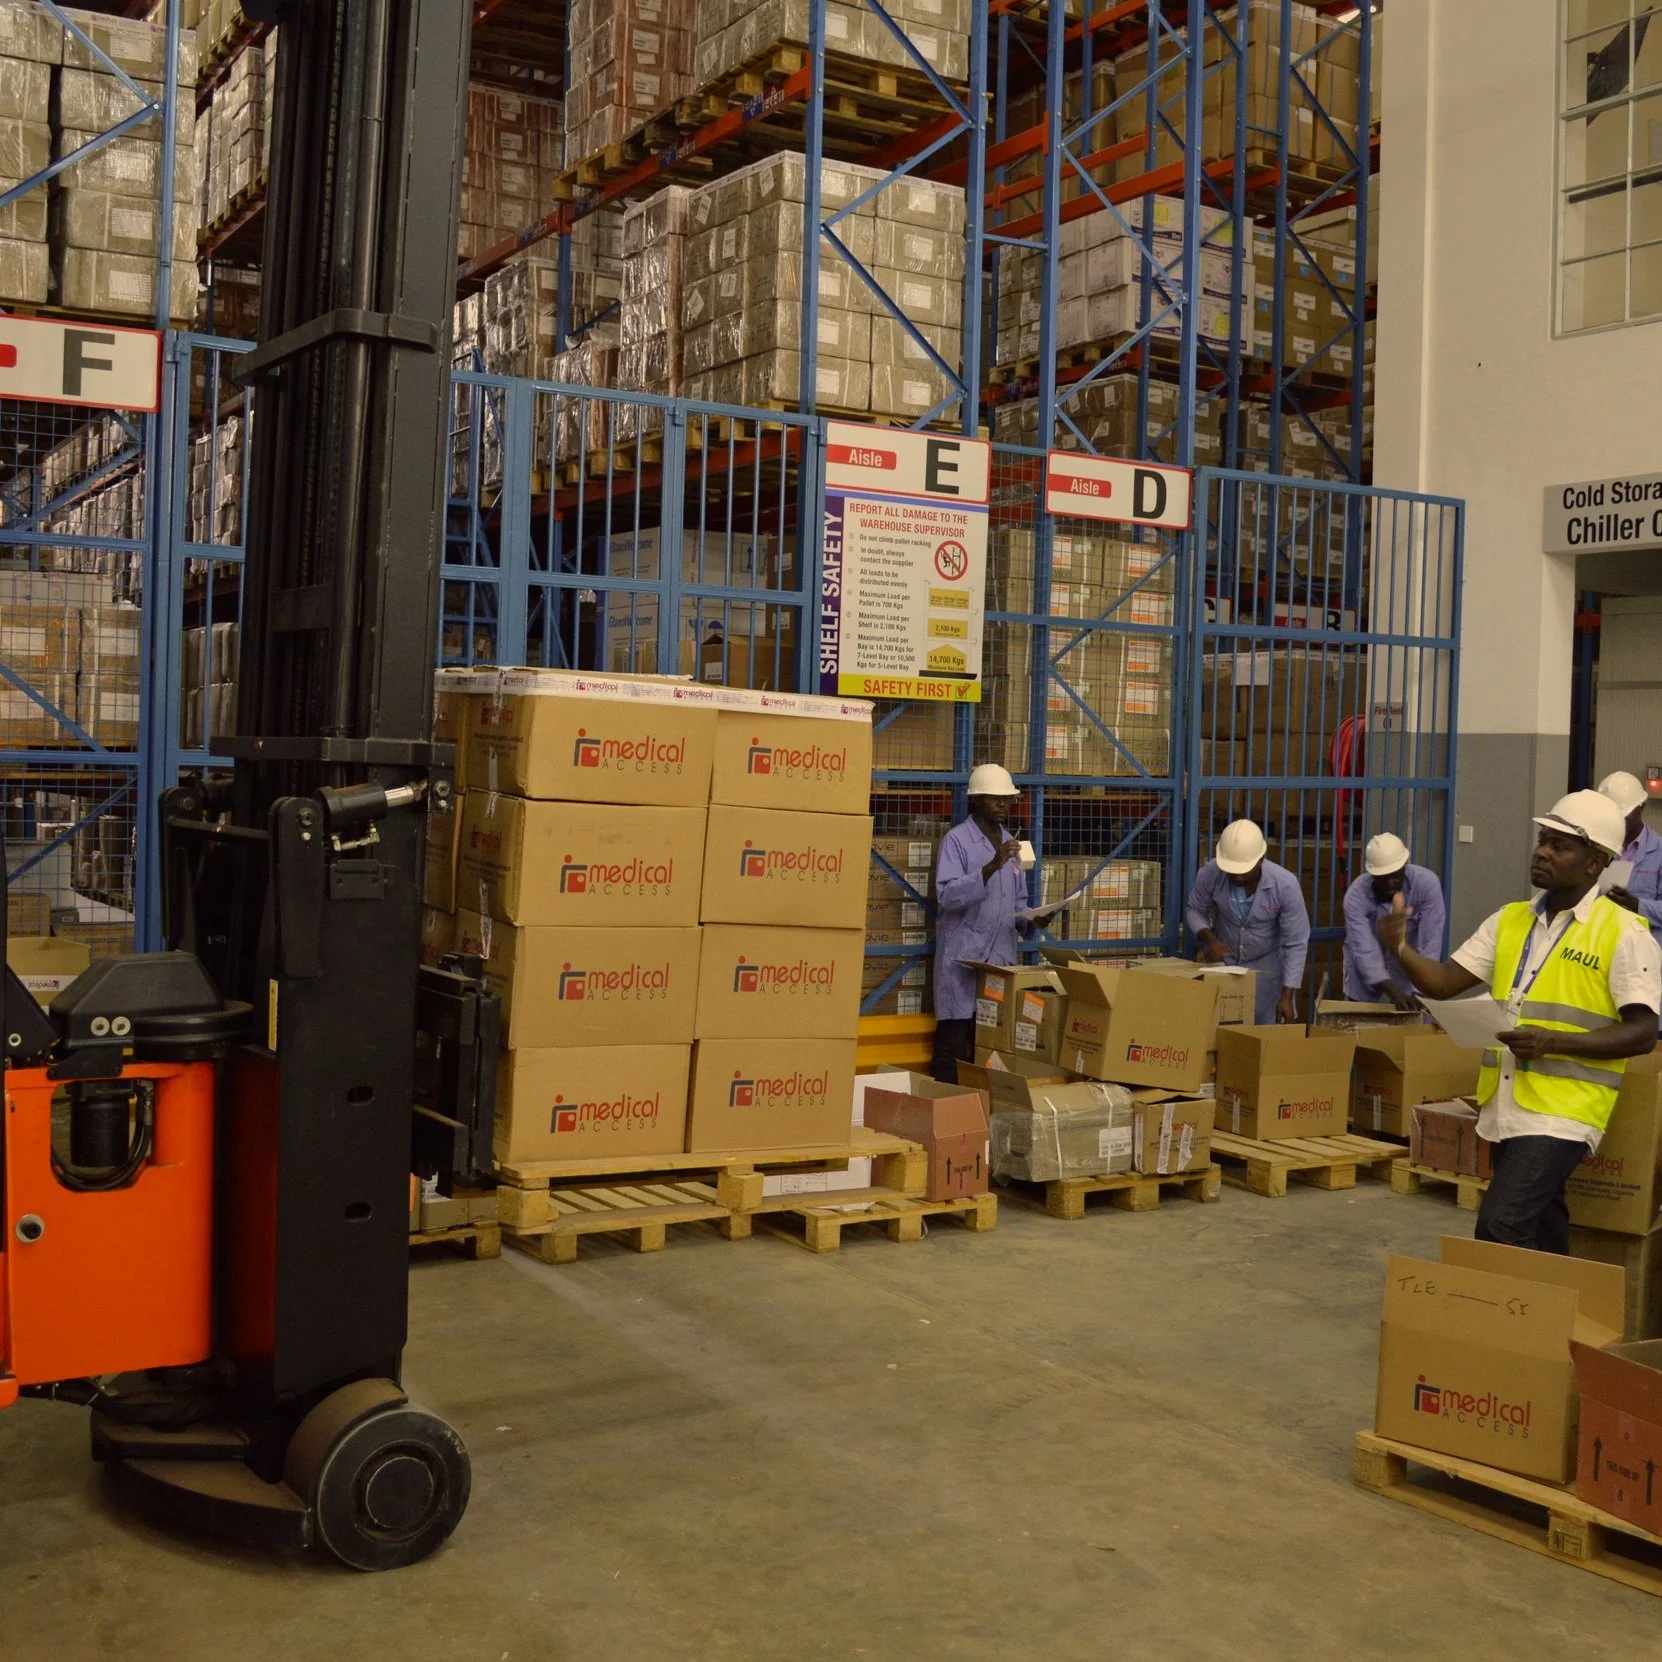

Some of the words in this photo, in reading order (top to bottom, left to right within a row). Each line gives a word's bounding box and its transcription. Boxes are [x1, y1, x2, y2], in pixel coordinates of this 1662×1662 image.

[62, 328, 115, 396] F
[848, 448, 883, 468] Aisle
[925, 438, 960, 495] E
[1070, 478, 1100, 496] Aisle
[1132, 468, 1167, 520] D
[1562, 484, 1604, 509] Cold
[850, 502, 882, 514] REPORT
[884, 505, 900, 518] ALL
[902, 508, 938, 522] DAMAGE
[940, 512, 950, 522] TO
[952, 514, 968, 525] THE
[860, 518, 912, 533] WAREHOUSE
[914, 524, 965, 538] SUPERVISOR
[1567, 513, 1644, 545] Chiller
[878, 536, 894, 544] climb
[894, 536, 910, 546] pallet
[911, 538, 932, 548] racking
[822, 511, 842, 598] SAFETY
[868, 548, 884, 556] doubt,
[886, 548, 904, 558] always
[860, 556, 881, 564] contact
[882, 556, 892, 564] the
[892, 558, 914, 568] supplier
[868, 568, 884, 577] loads
[860, 577, 890, 586] distributed
[890, 580, 908, 588] evenly
[859, 590, 886, 600] Maximum
[888, 592, 900, 600] Load
[858, 600, 875, 608] Pallet
[893, 602, 904, 610] Kgs
[858, 612, 886, 622] Maximum
[886, 614, 900, 622] Load
[858, 621, 873, 629] Shelf
[880, 622, 895, 630] 2,100
[896, 623, 906, 631] Kgs
[820, 604, 840, 674] SHELF
[857, 643, 868, 651] Bay
[858, 634, 885, 643] Maximum
[886, 635, 899, 643] Load
[878, 653, 889, 662] Bay
[930, 656, 950, 664] 14,700
[952, 657, 964, 666] Kgs
[857, 662, 868, 670] Kgs
[878, 662, 898, 670] 5-Level
[899, 664, 909, 672] Bay
[864, 679, 912, 695] SAFETY
[916, 682, 952, 697] FIRST
[602, 735, 686, 764] medical
[772, 744, 846, 772] medical
[602, 758, 682, 775] ACCESS
[772, 765, 845, 782] ACCESS
[767, 846, 844, 873] medical
[588, 858, 673, 885] medical
[767, 868, 840, 884] ACCESS
[588, 883, 671, 896] ACCESS
[1560, 947, 1600, 970] MAUL
[587, 962, 670, 990] medical
[759, 960, 835, 985] medical
[586, 988, 668, 1000] ACCESS
[759, 982, 832, 995] ACCESS
[1142, 1044, 1190, 1062] medical
[755, 1070, 828, 1097] medical
[579, 1091, 660, 1121] medical
[754, 1095, 826, 1108] ACCESS
[1291, 1096, 1334, 1113] medical
[578, 1117, 658, 1133] ACCESS
[1398, 1276, 1438, 1296] TLE
[1442, 1388, 1531, 1427] medical
[1442, 1408, 1530, 1439] ACCESS
